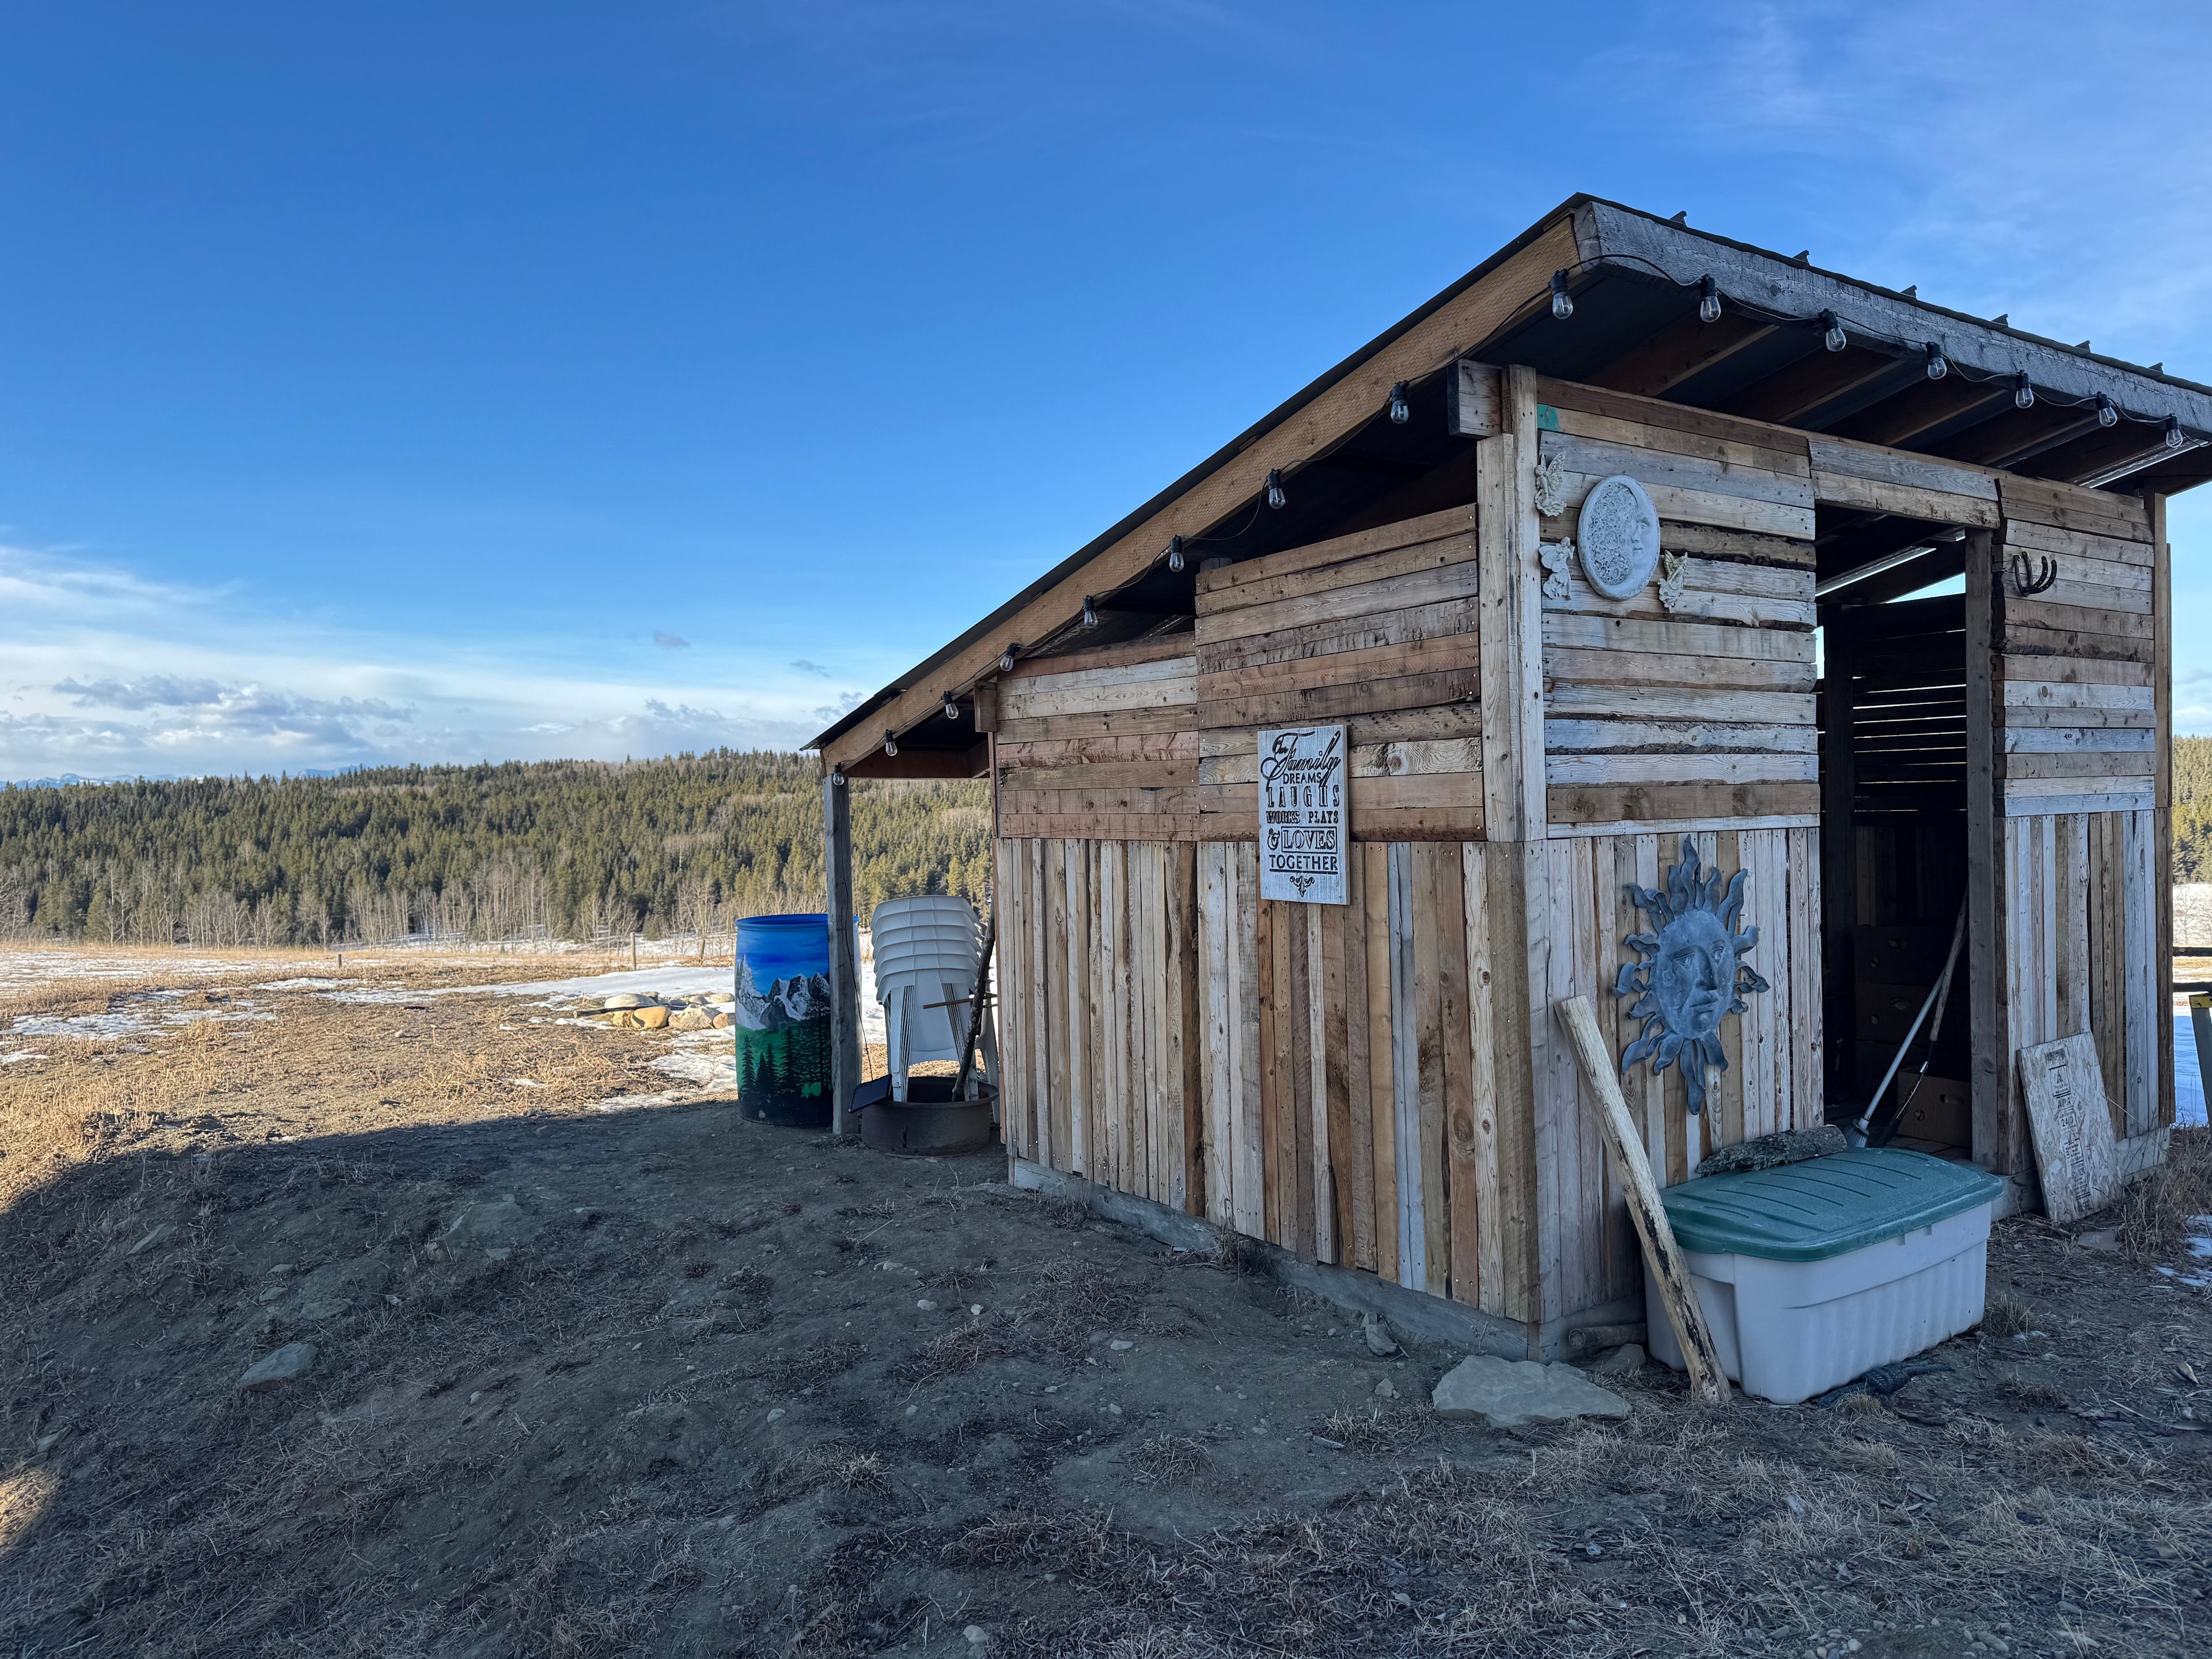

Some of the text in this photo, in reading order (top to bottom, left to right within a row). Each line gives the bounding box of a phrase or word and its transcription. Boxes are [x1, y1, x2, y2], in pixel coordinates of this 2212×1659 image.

[1272, 736, 1289, 755] Our
[1260, 730, 1341, 792] Family
[1283, 772, 1321, 785] DREAMS
[1268, 785, 1340, 807] LAUGHS
[1266, 810, 1339, 824] WORKS PLAYS
[1267, 828, 1335, 850] & LOVES
[1269, 854, 1338, 870] TOGETHER
[2057, 1097, 2071, 1109] APA
[2061, 1116, 2074, 1127] 24/0
